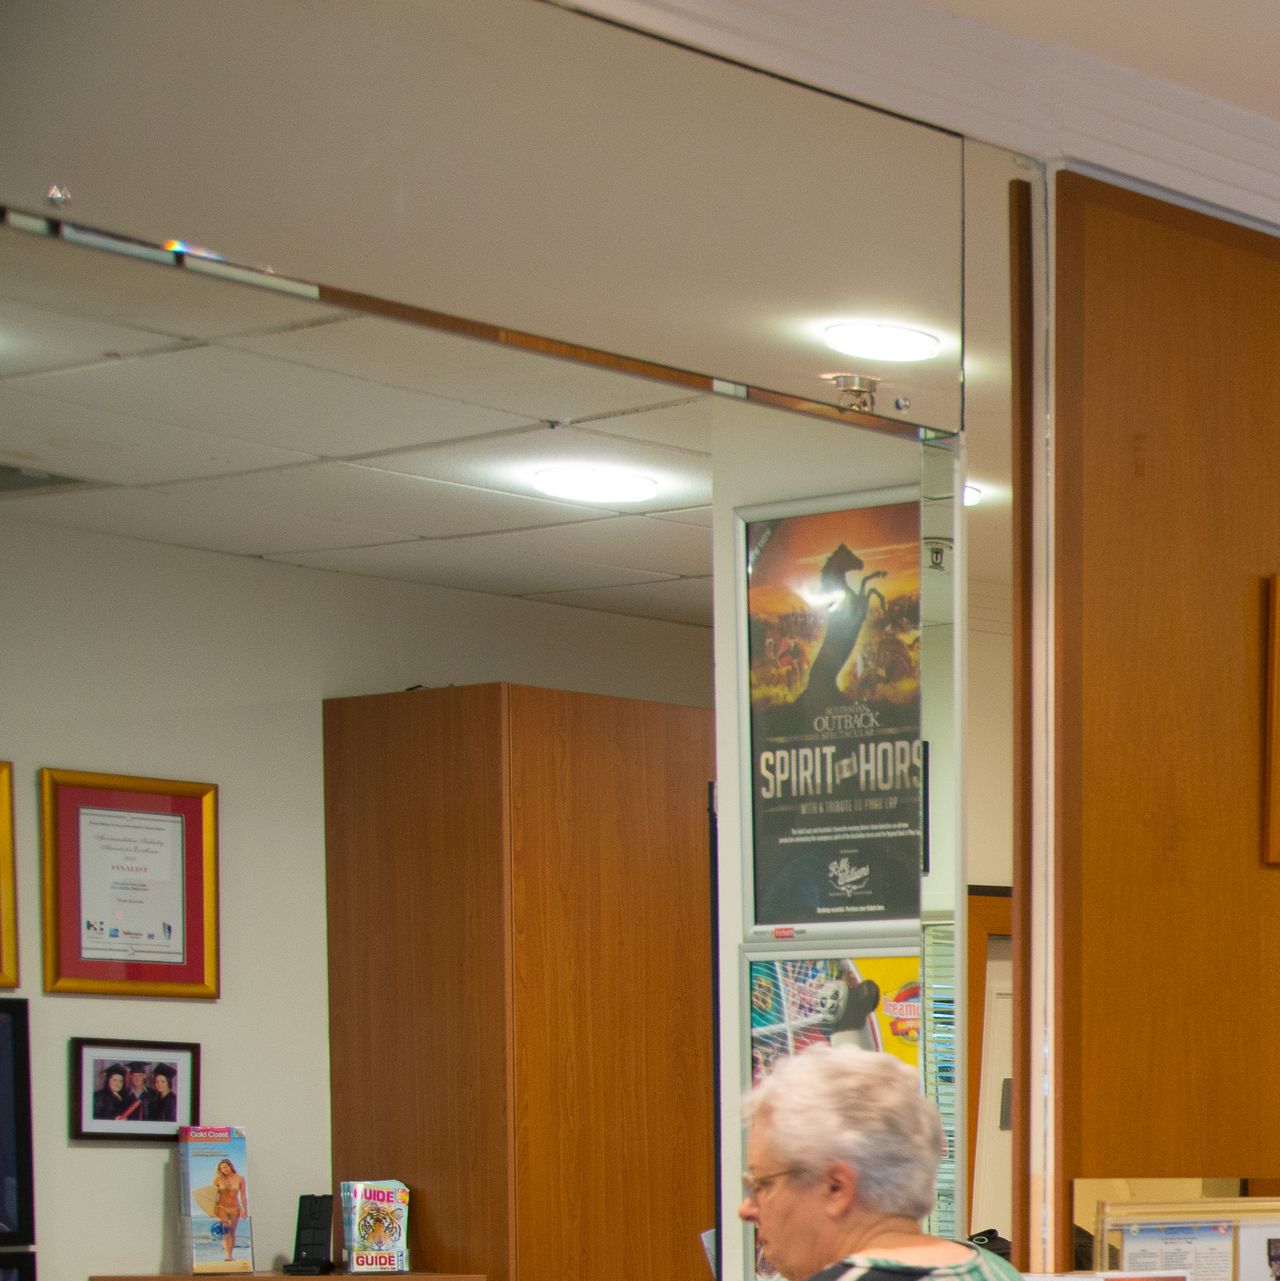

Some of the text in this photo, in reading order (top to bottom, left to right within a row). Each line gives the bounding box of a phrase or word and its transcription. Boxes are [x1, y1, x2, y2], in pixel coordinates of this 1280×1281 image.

[814, 713, 880, 732] OUTBACK
[761, 746, 836, 798] SPIRIT
[356, 1256, 395, 1266] GUIDE
